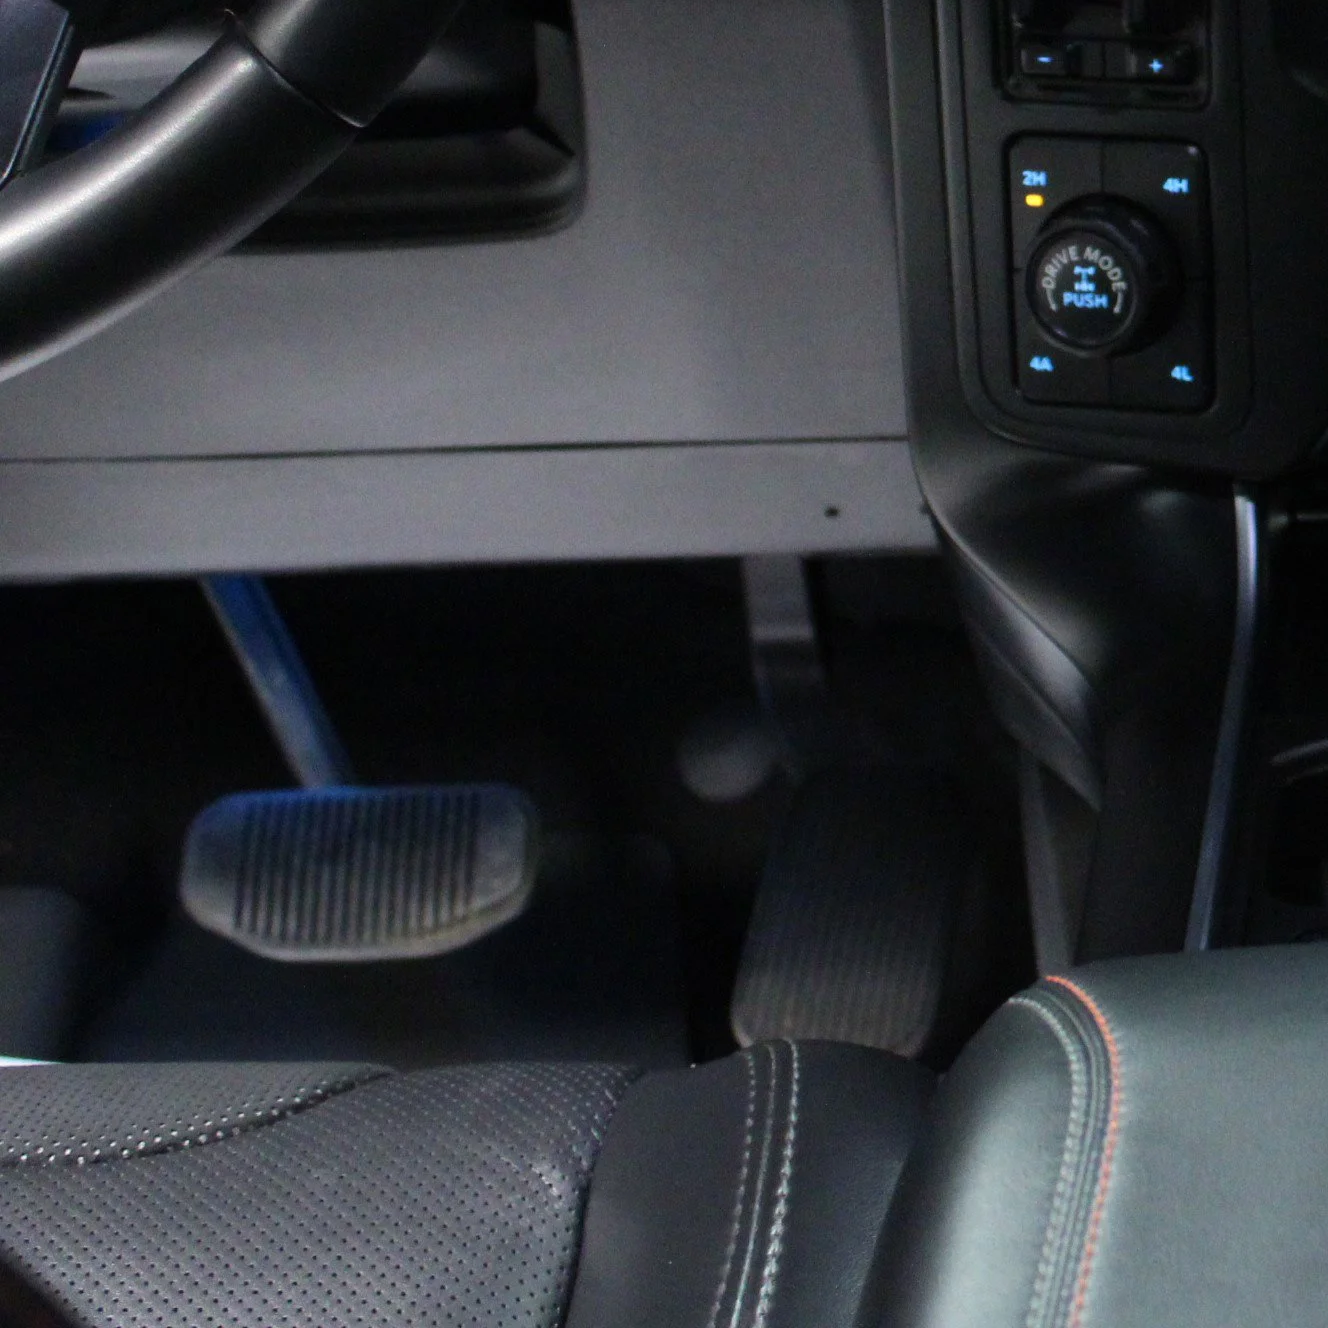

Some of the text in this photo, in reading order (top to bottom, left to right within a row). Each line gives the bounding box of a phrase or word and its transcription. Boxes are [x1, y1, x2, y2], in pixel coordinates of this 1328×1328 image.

[1022, 170, 1047, 187] 2H
[1163, 178, 1189, 194] 4H
[1042, 246, 1128, 291] DRIVE MODE
[1063, 292, 1108, 308] PUSH
[1029, 356, 1054, 372] 4A
[1171, 365, 1194, 382] 4L
